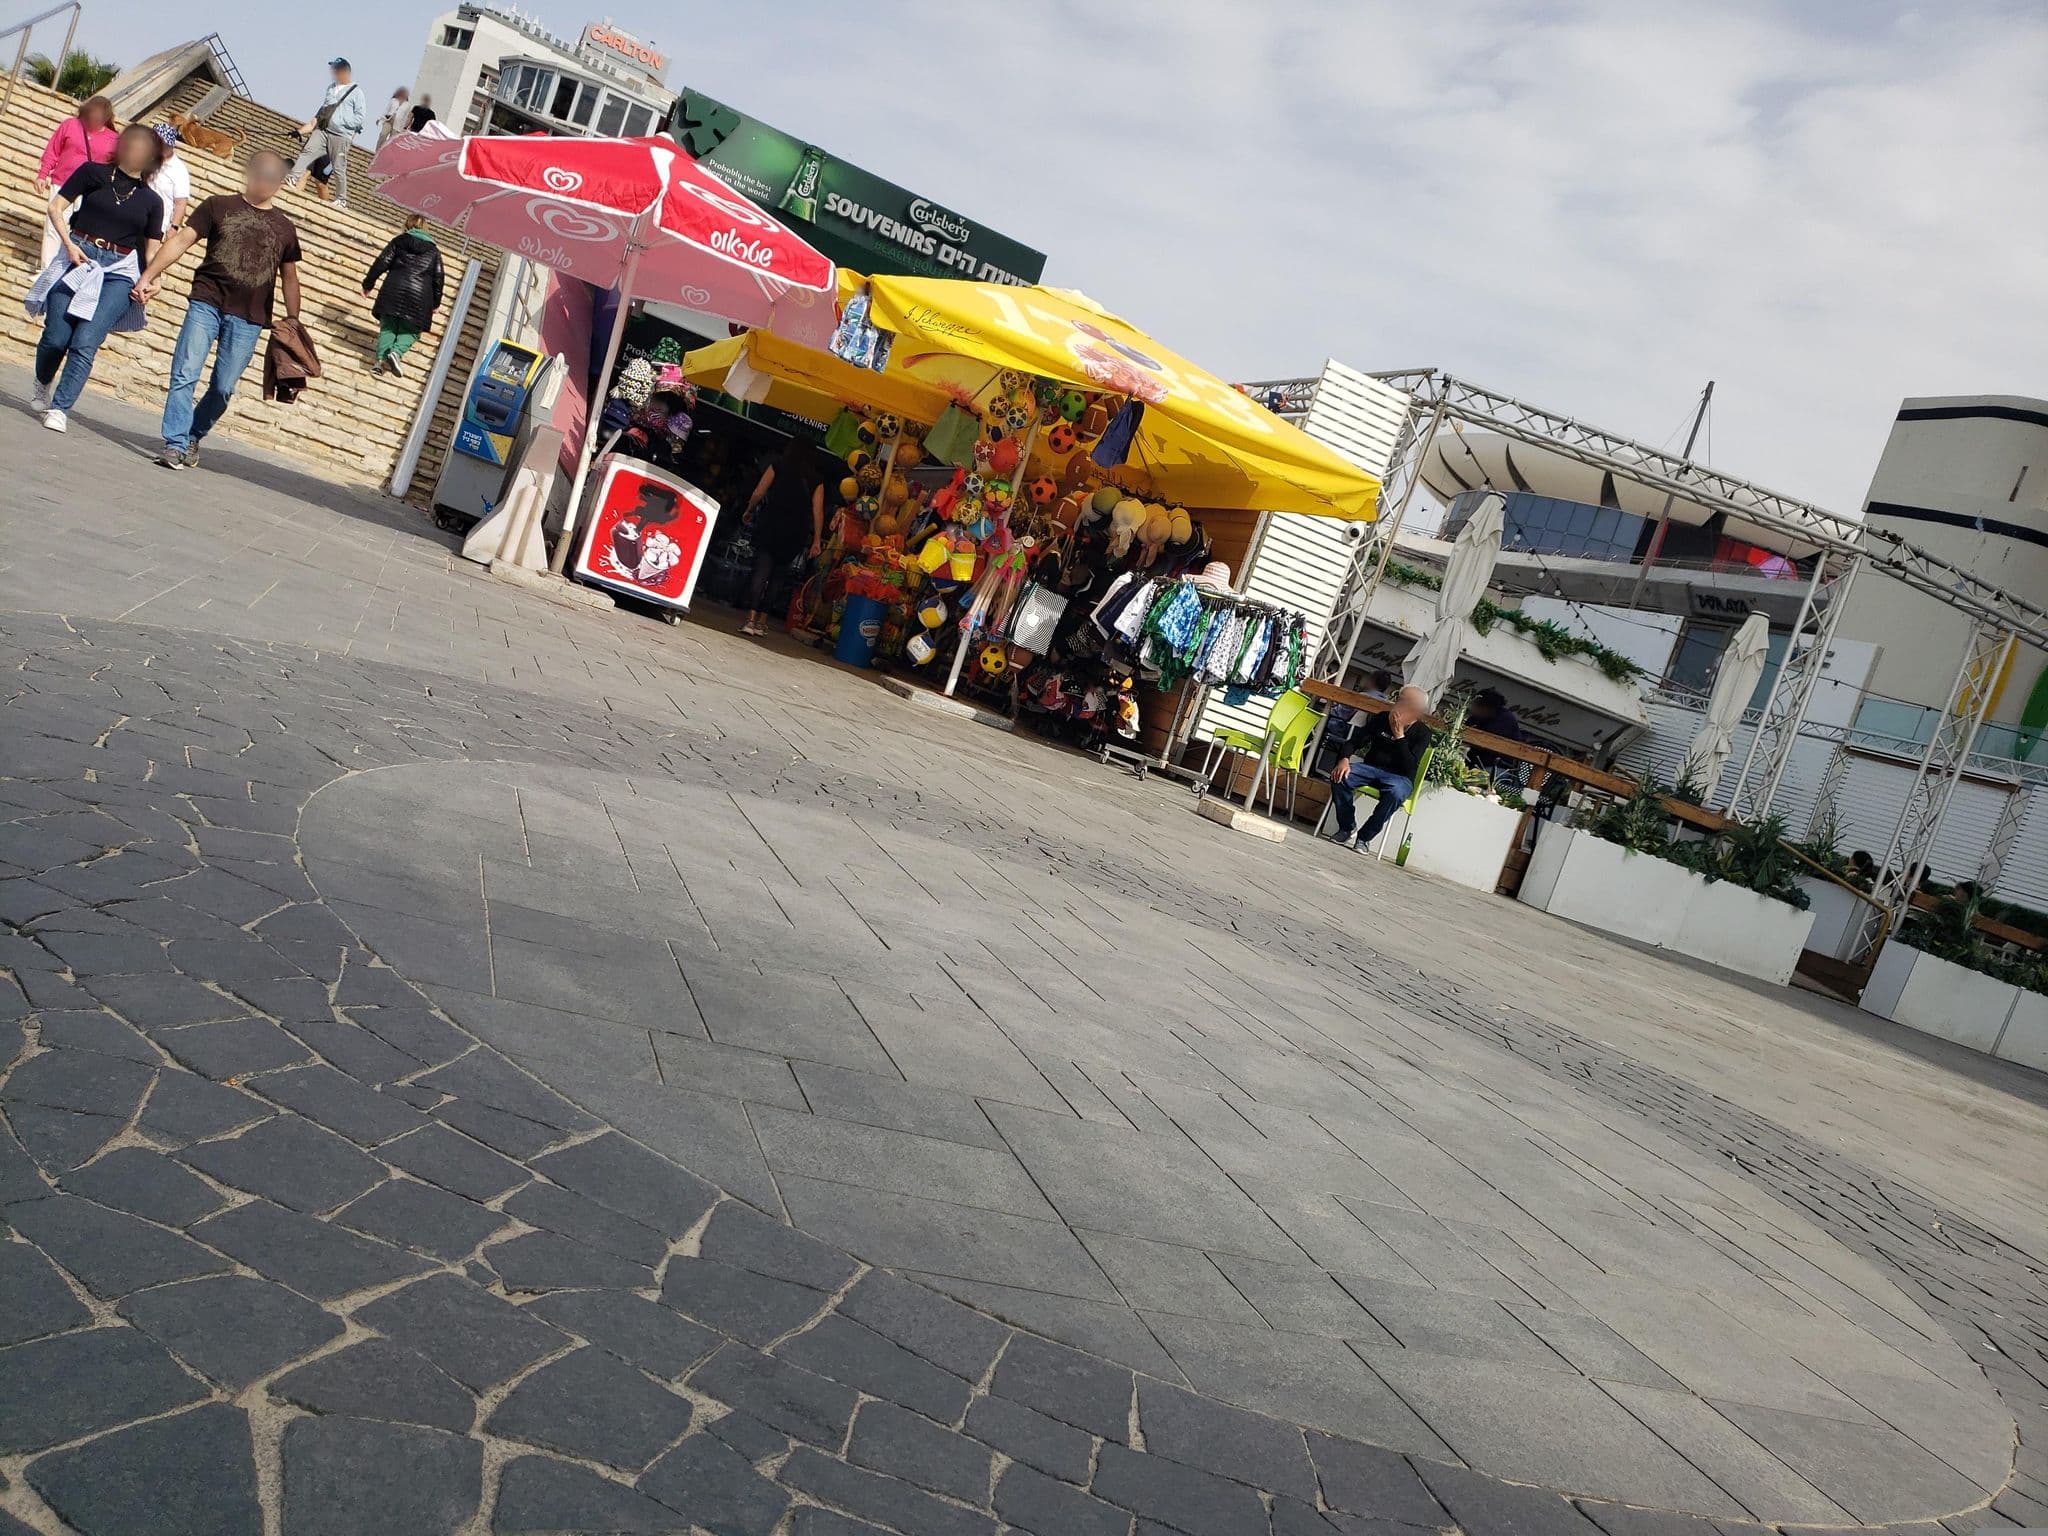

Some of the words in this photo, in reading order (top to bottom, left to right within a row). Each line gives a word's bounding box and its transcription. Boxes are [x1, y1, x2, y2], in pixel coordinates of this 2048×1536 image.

[590, 25, 664, 70] CARLTON
[709, 159, 743, 180] Probably
[743, 175, 755, 186] the
[756, 180, 772, 193] best
[725, 174, 732, 184] in
[733, 179, 746, 190] the
[747, 185, 770, 201] world.
[825, 192, 938, 256] SOUVENIRS
[936, 243, 978, 275] הים
[909, 199, 971, 243] Carlsberg
